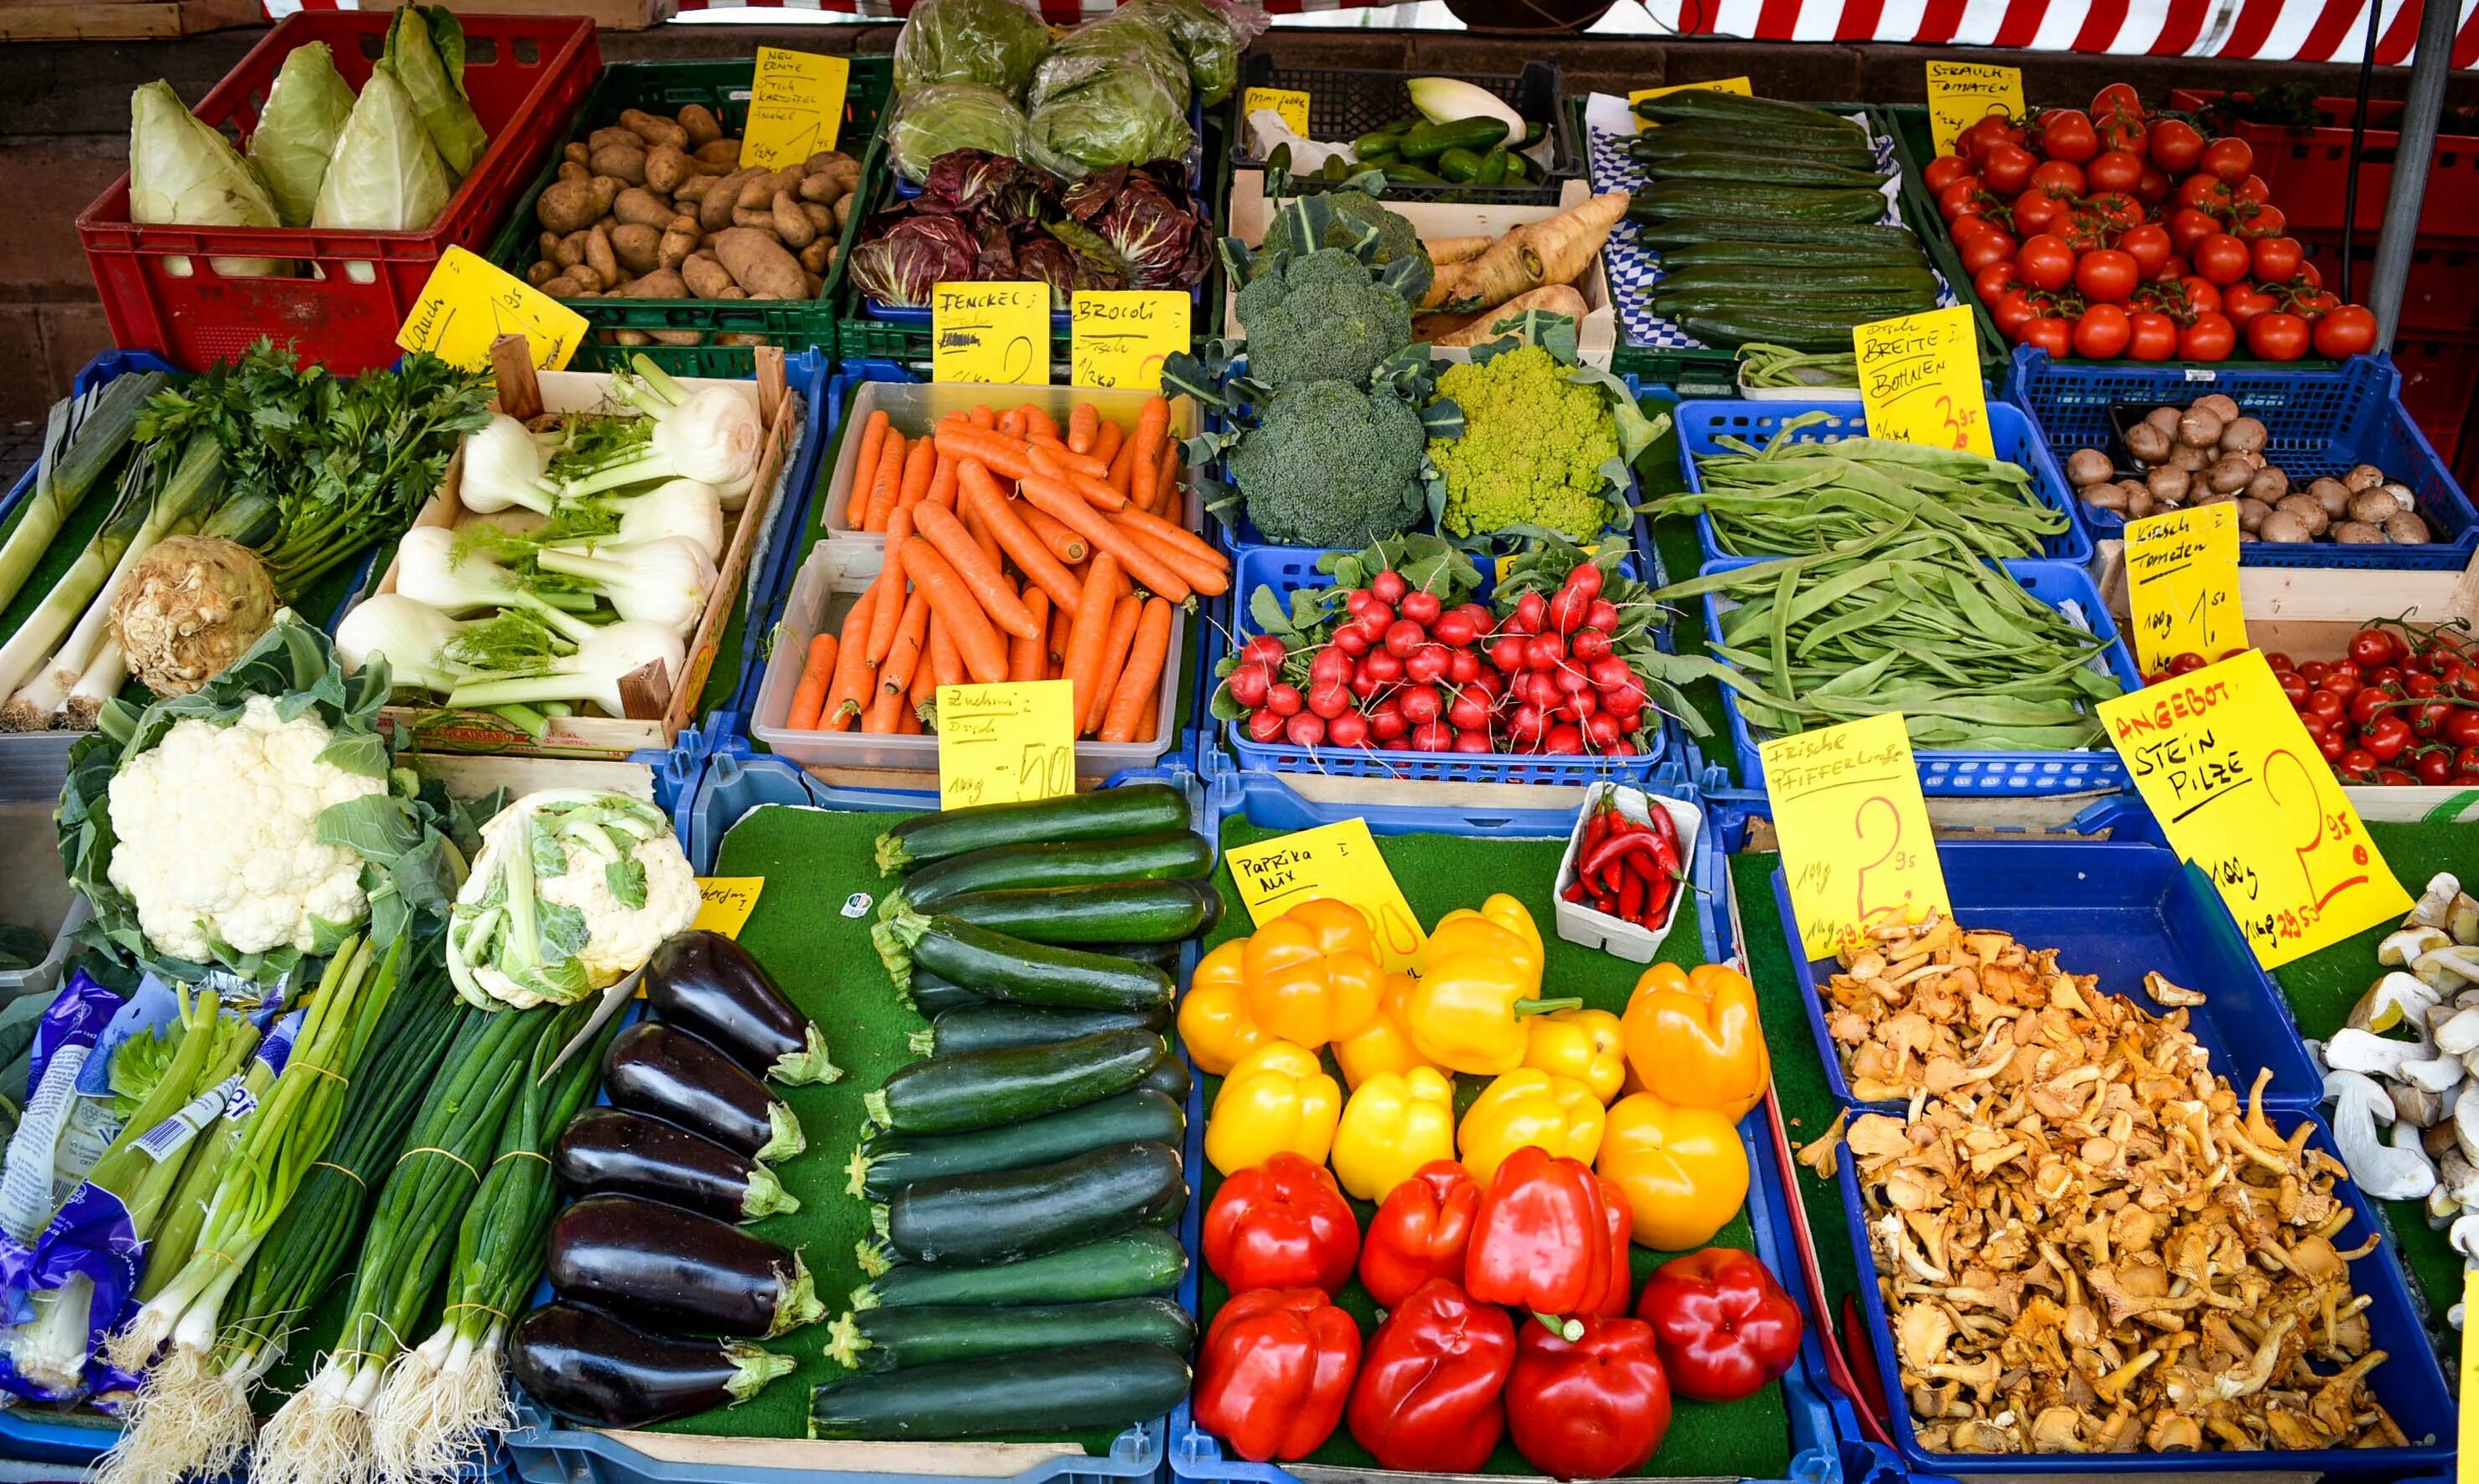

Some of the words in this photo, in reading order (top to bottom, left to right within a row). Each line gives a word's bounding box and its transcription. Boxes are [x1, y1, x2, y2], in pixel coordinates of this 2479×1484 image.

[763, 61, 802, 72] ERNTE
[1863, 330, 1938, 363] BREITE
[1871, 360, 1946, 399] BOHNEN
[2116, 681, 2229, 744] ANGEBOT
